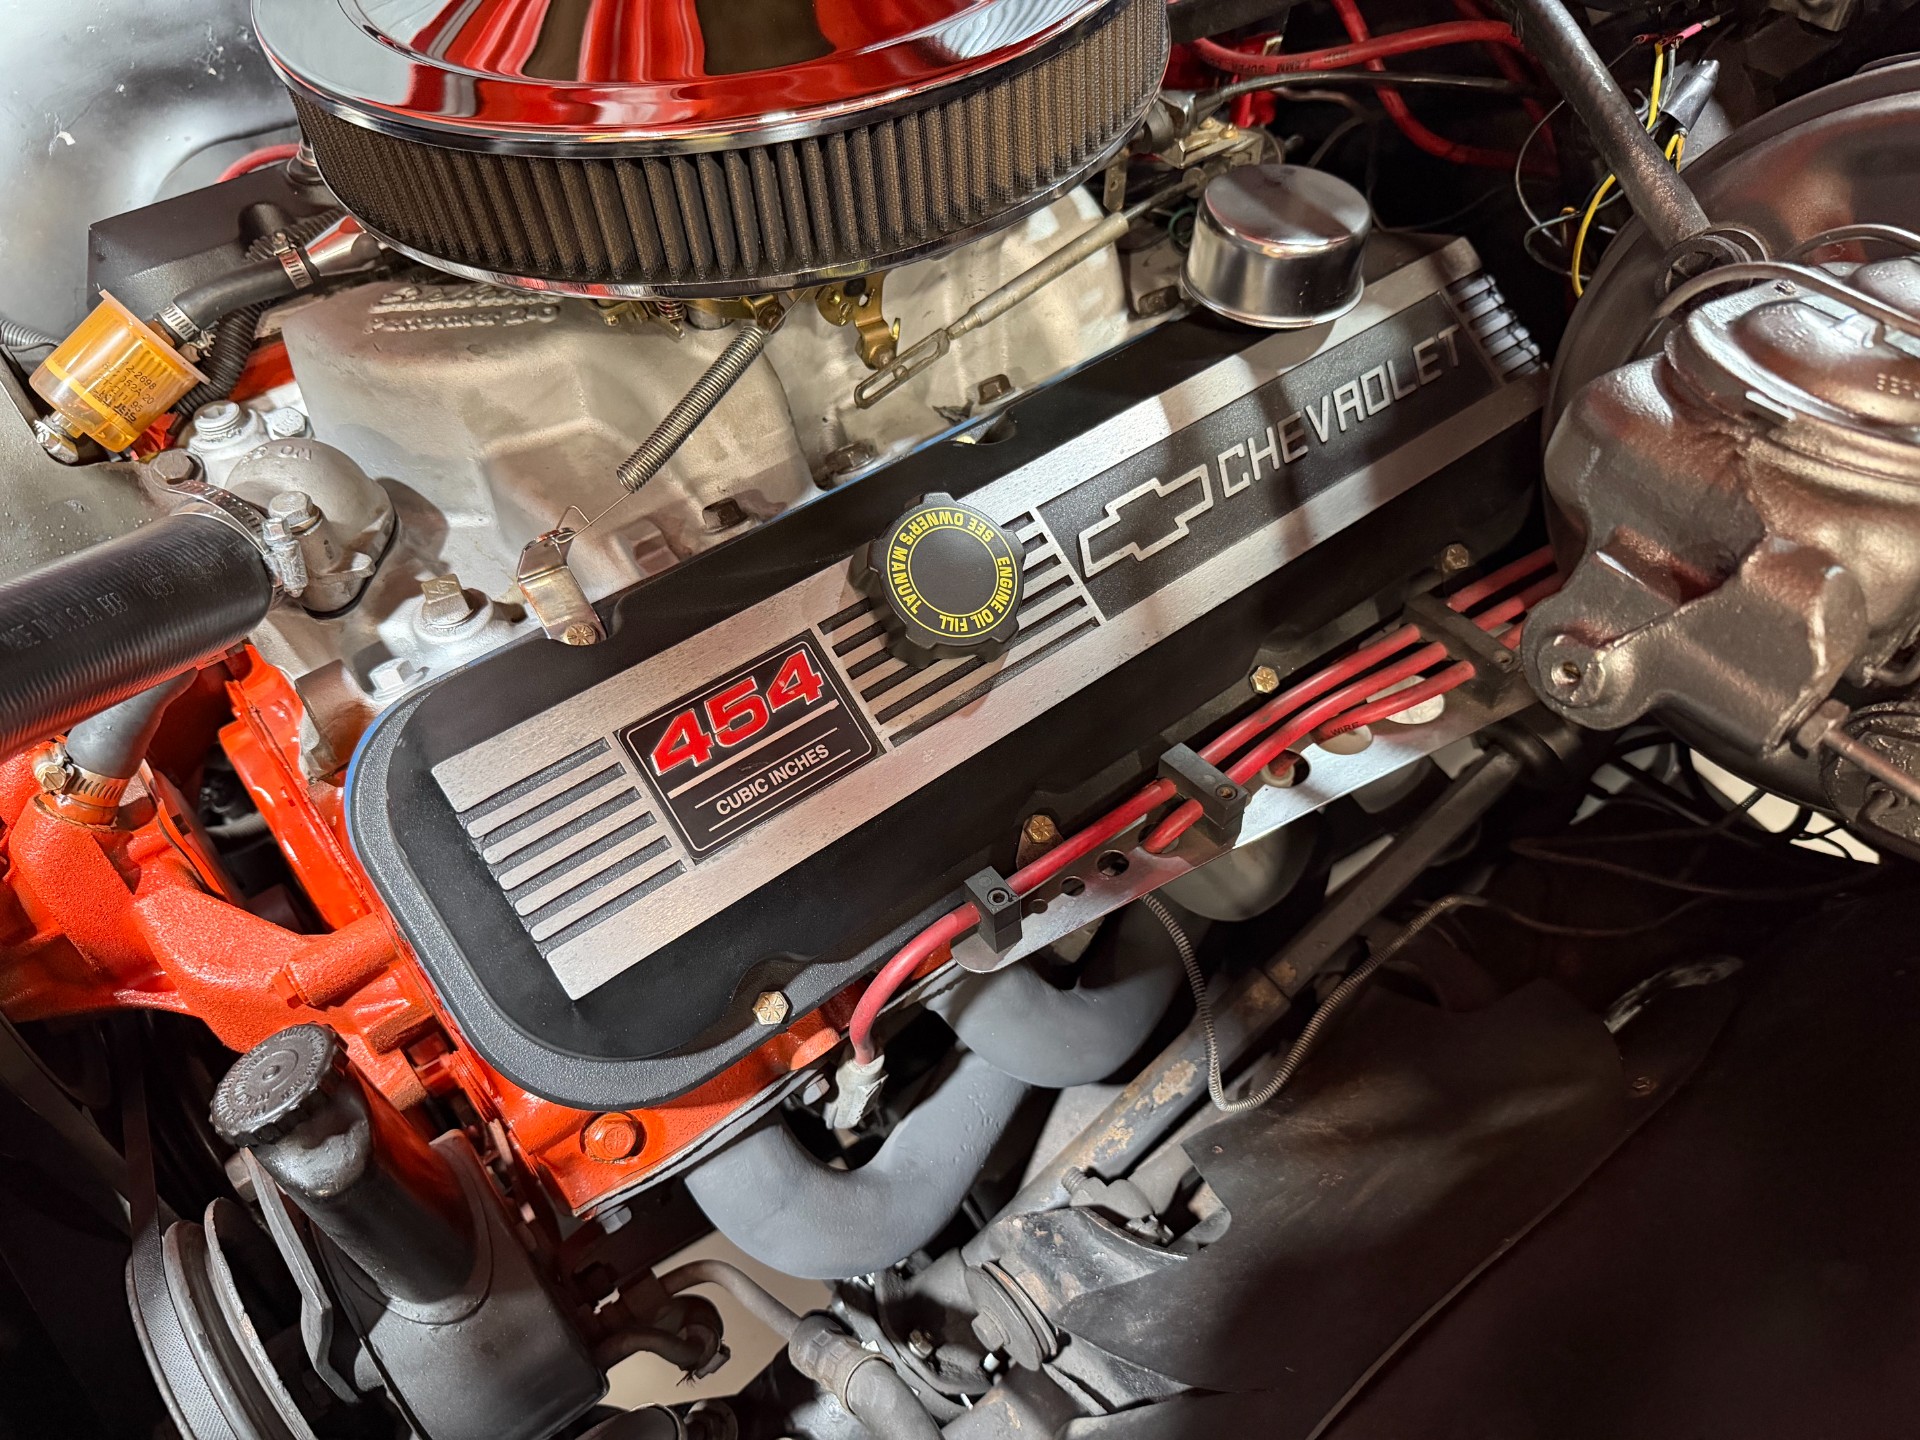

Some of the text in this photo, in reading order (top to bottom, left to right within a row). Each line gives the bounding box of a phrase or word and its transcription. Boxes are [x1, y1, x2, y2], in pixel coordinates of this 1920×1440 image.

[1217, 323, 1460, 498] CHEVROLET
[891, 511, 995, 615] SEE OWNER'S MANUAL
[939, 556, 1013, 633] ENGINE OIL FILL
[650, 648, 825, 777] 454
[1329, 721, 1359, 736] WIRE
[715, 743, 830, 816] CUBIC INCHES
